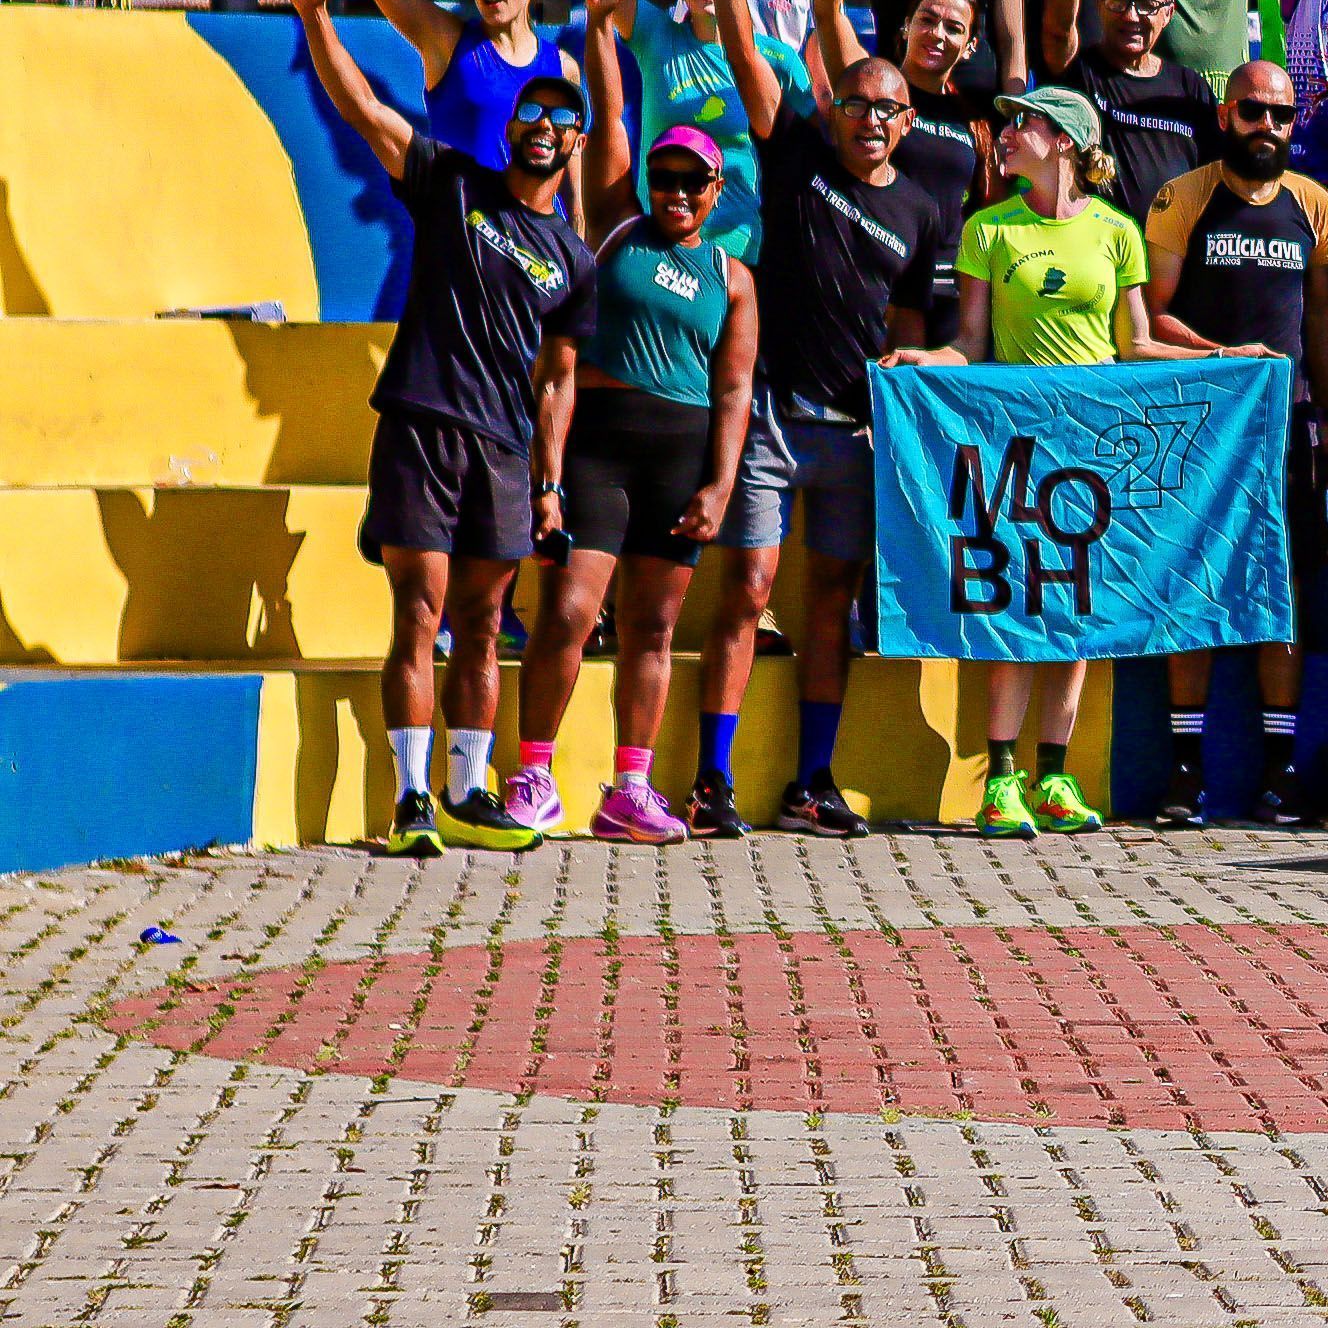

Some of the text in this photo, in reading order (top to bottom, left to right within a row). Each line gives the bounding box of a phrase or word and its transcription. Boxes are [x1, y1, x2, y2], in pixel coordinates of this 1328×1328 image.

[1102, 215, 1126, 229] 2026
[1207, 234, 1303, 261] POLÍCIA CIVIL
[1002, 249, 1055, 284] MARATONA
[1219, 258, 1241, 266] ANOS
[1257, 259, 1281, 268] MINAS
[1282, 261, 1304, 270] GERAIS
[947, 401, 1212, 546] MO 27
[948, 534, 1092, 616] BH
